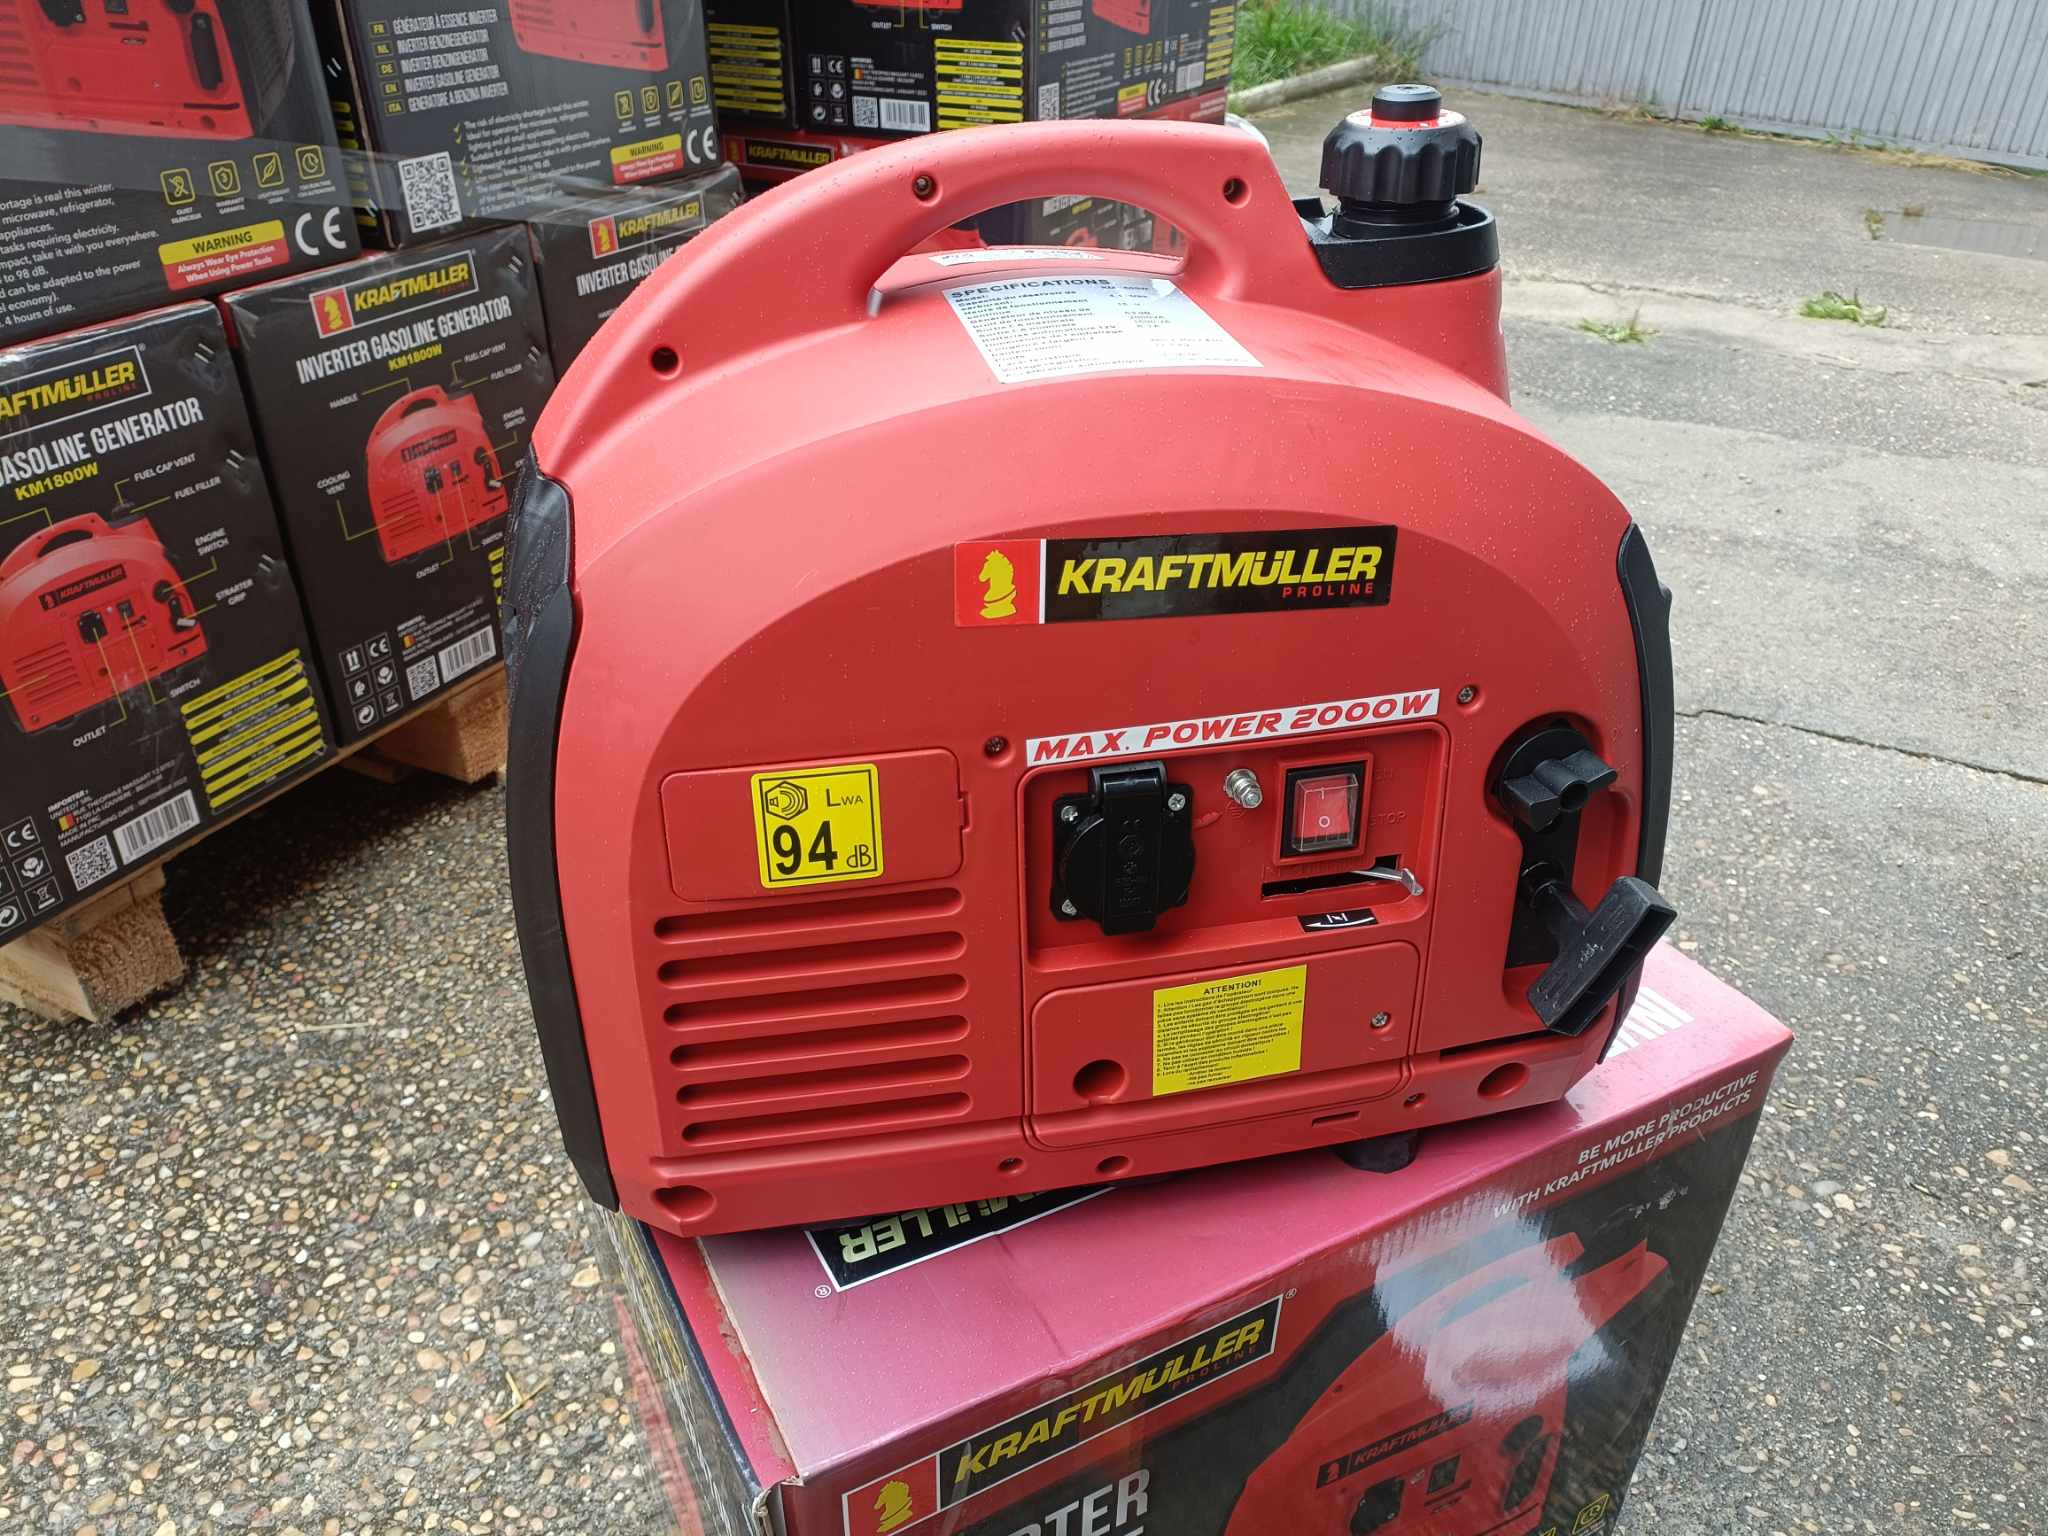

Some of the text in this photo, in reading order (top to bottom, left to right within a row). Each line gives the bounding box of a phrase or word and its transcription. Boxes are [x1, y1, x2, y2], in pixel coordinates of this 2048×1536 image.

[373, 23, 385, 34] FR
[381, 63, 393, 74] DE
[385, 83, 398, 94] EN
[630, 142, 664, 157] WARNING
[192, 231, 254, 254] WARNING
[295, 206, 347, 256] CE
[576, 263, 629, 297] INVERTER
[951, 279, 1111, 299] SPECIFICATIONS
[295, 295, 513, 386] INVERTER GASOLINE GENERATOR
[388, 343, 443, 373] KM1800W
[91, 397, 204, 455] GENERATOR
[134, 452, 197, 483] FUEL CAP VENT
[14, 462, 99, 501] KM1800W
[174, 476, 222, 500] FUEL FILLER
[194, 527, 227, 547] ENGINE
[197, 537, 230, 557] SWITCH
[1057, 545, 1383, 596] KRAFTMÜLLER
[1282, 582, 1375, 600] PROLINE
[170, 678, 200, 699] SWITCH
[73, 725, 107, 748] OUTLET
[1033, 692, 1433, 763] MAX. POWER 2000W
[7, 823, 36, 848] CE
[772, 820, 872, 876] 94 dB
[1203, 978, 1262, 996] ATTENTION!
[1578, 1069, 1760, 1165] BE MORE PRODUCTIVE
[1494, 1088, 1752, 1220] WITH KRAFTMULLER PRODUCTS
[954, 1318, 1266, 1485] KRAFTMÜLLER
